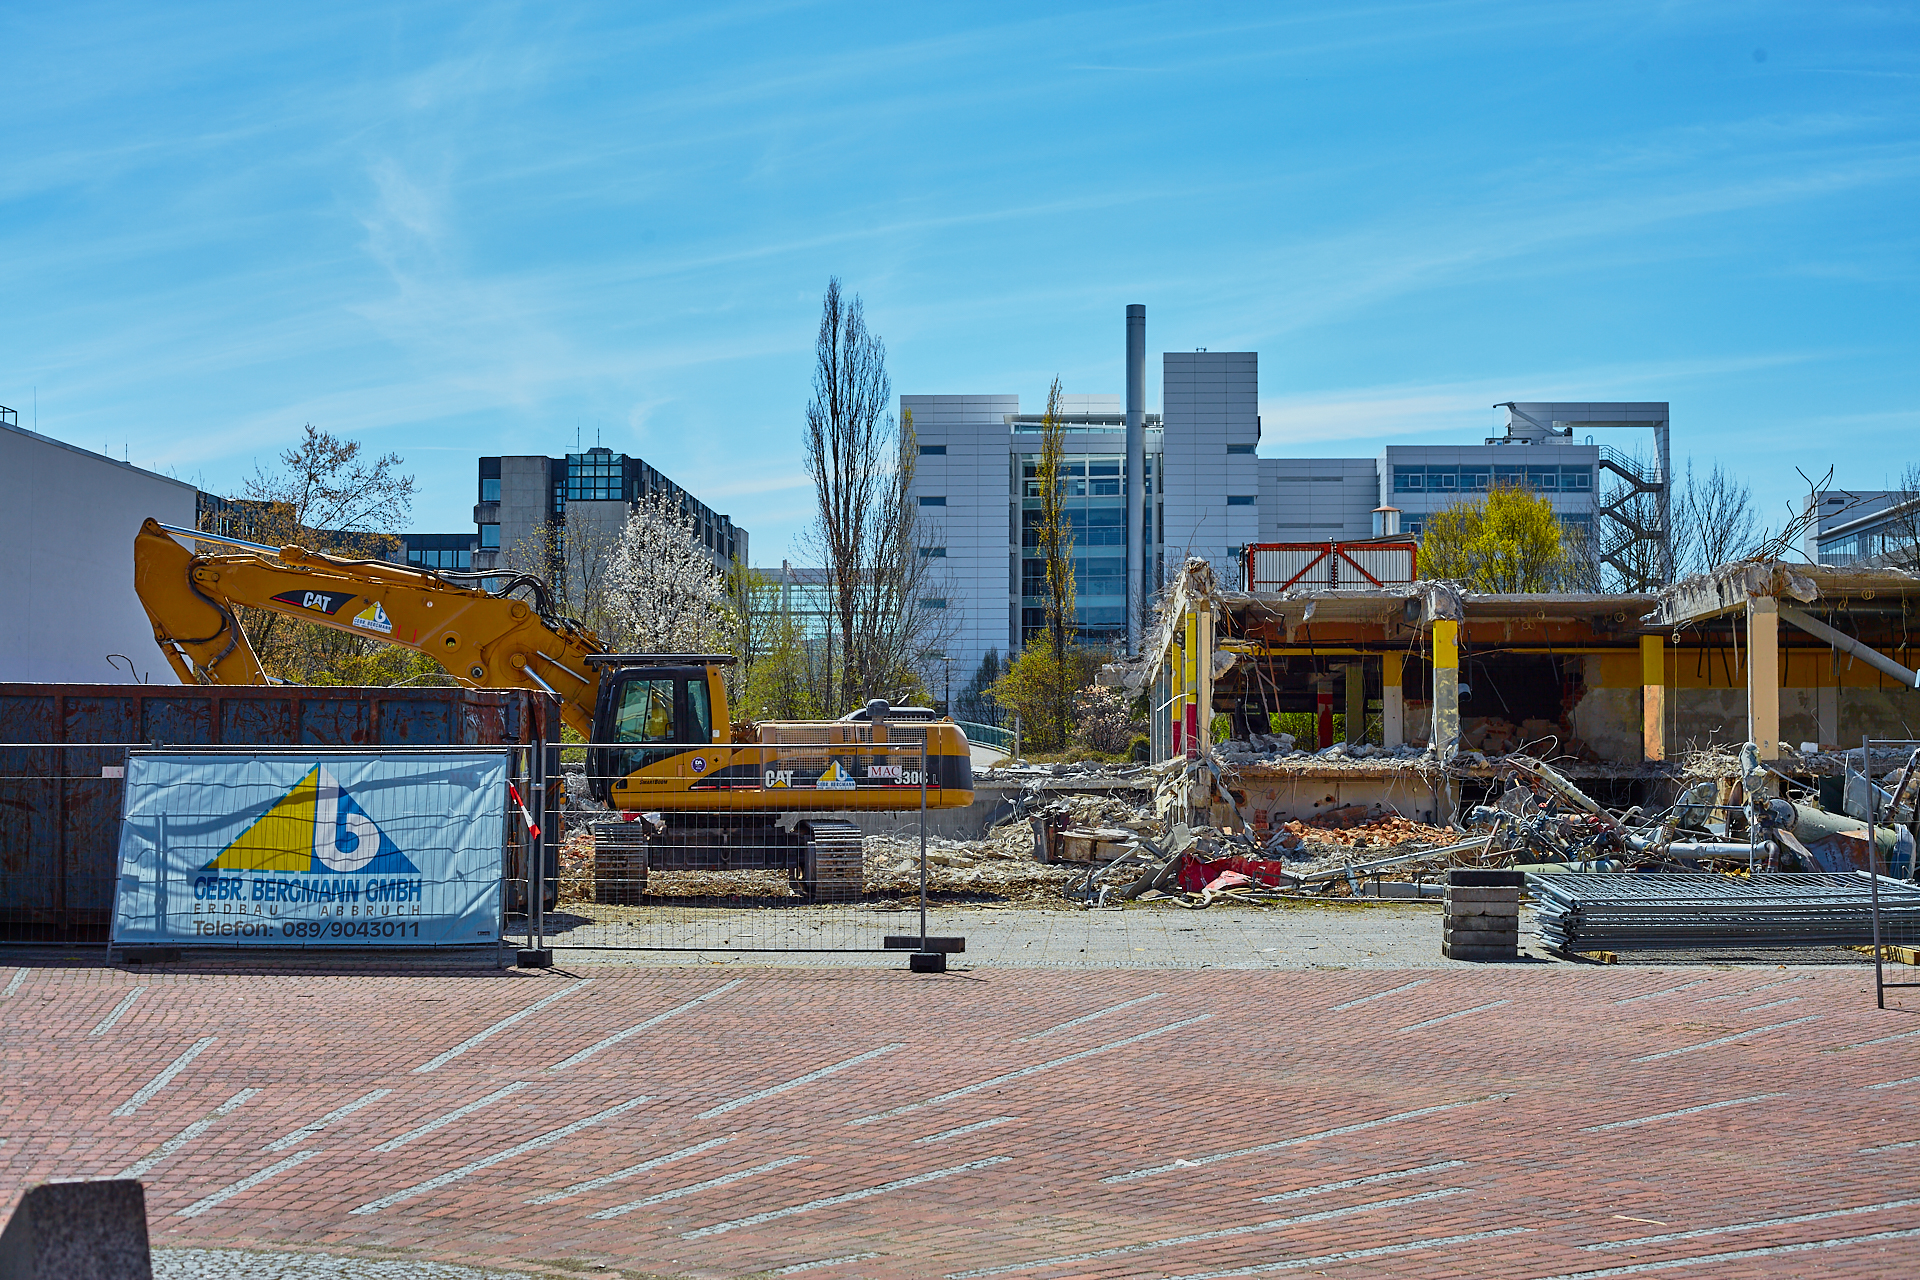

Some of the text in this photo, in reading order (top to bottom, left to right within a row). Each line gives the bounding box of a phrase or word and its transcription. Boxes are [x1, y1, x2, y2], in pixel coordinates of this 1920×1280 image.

[303, 591, 332, 613] CAT
[765, 770, 793, 788] CAT
[871, 766, 900, 777] MAC
[194, 876, 421, 903] GEBR. BERGMANN GMBH
[194, 903, 420, 916] ERDBAU ABBRUCH
[193, 920, 419, 938] Telefon: 089/9043011
